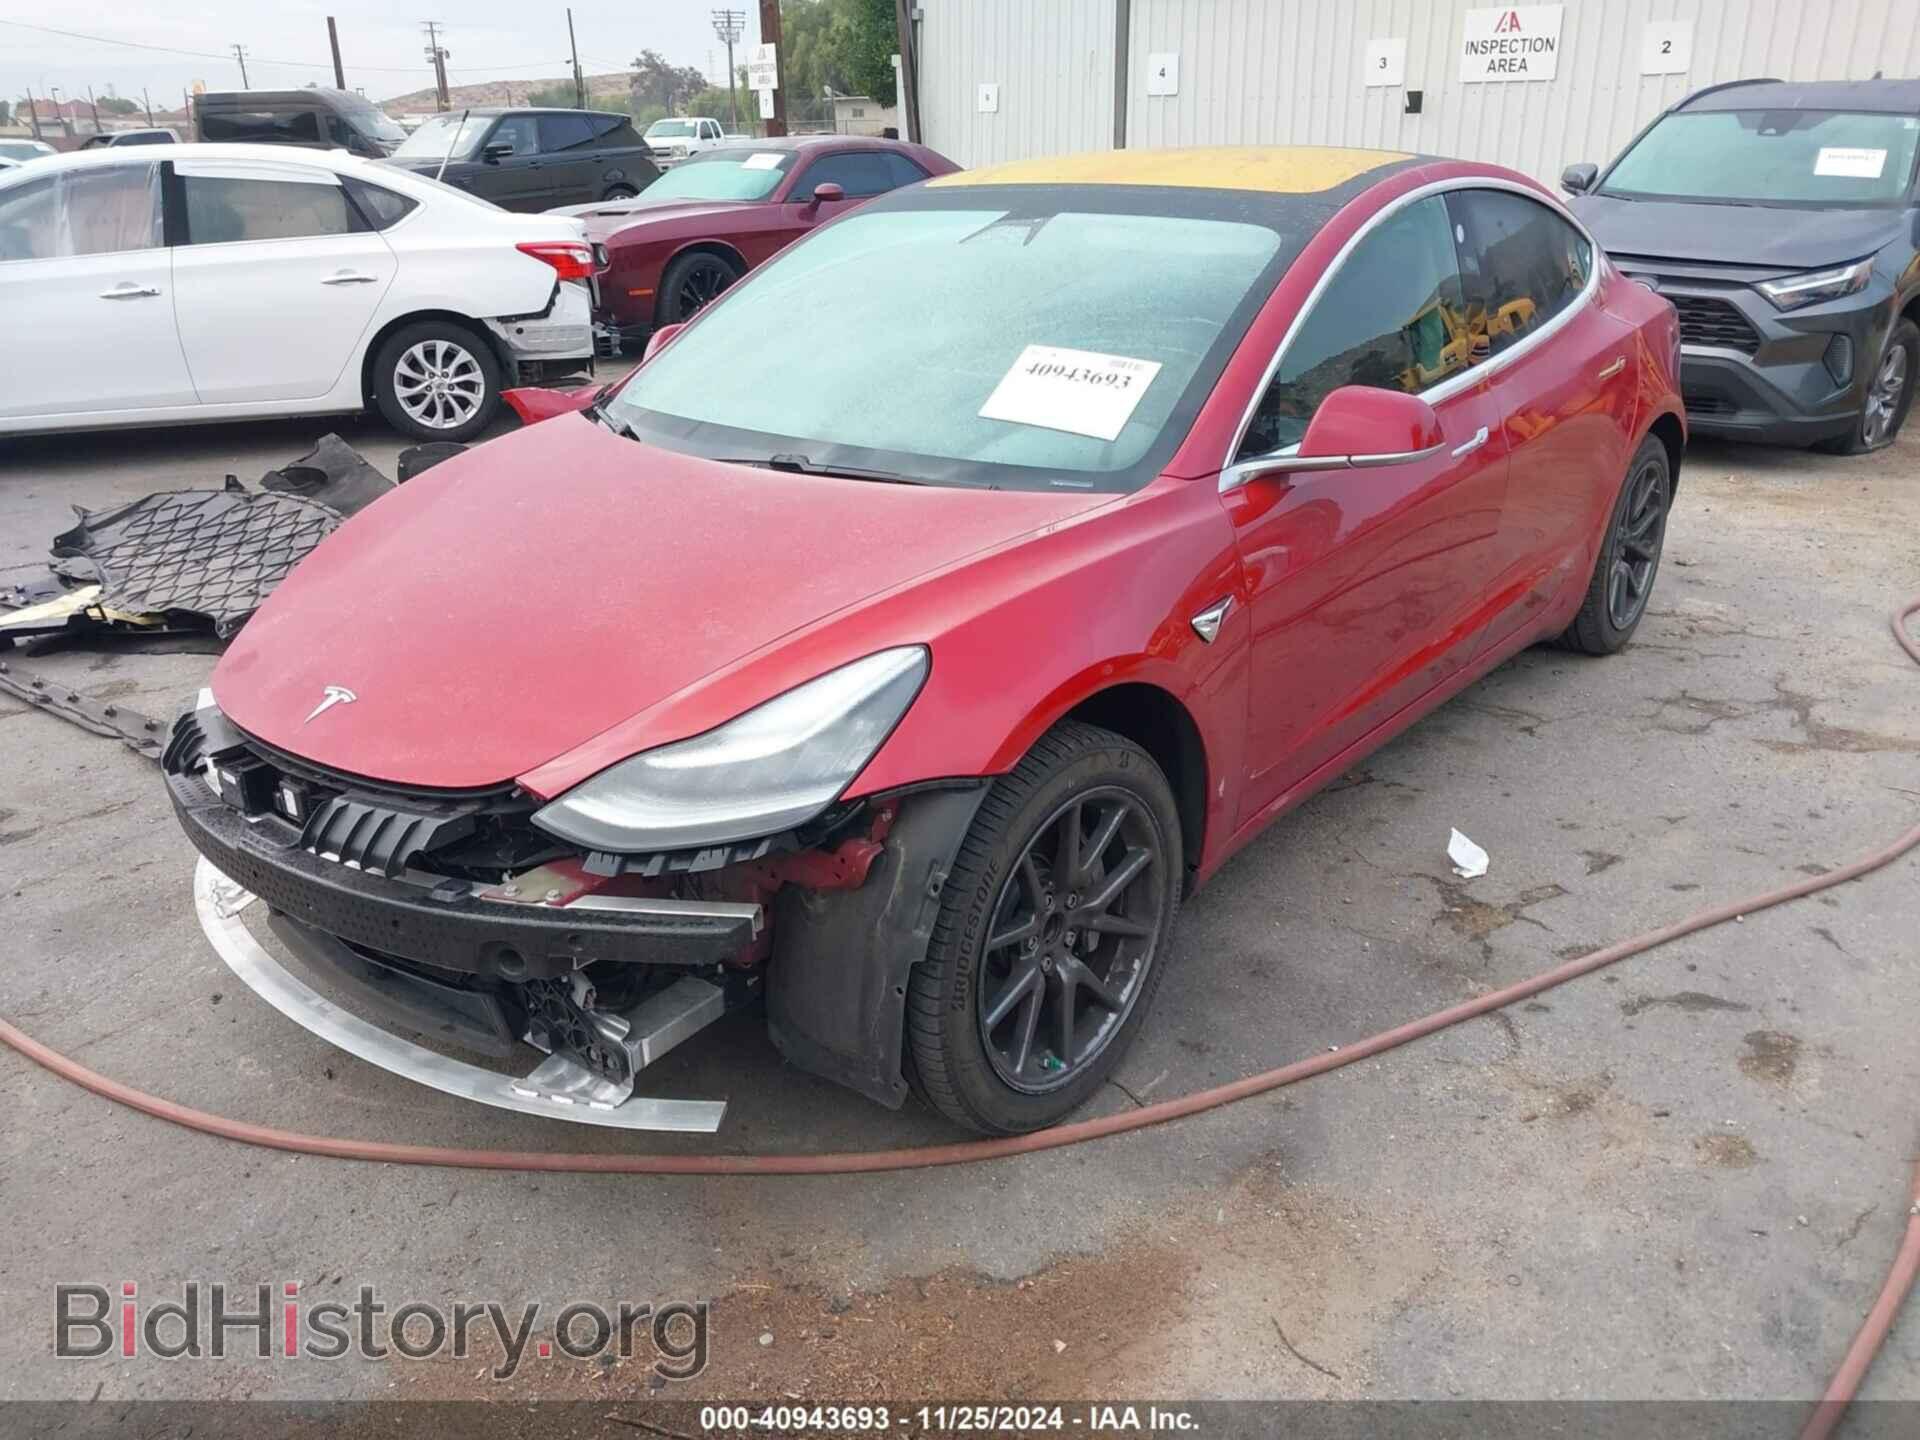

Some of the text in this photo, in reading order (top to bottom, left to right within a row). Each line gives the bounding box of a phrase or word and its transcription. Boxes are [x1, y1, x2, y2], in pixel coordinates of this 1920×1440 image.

[1464, 36, 1556, 56] INSPECTION
[1660, 39, 1672, 54] 2
[1378, 56, 1388, 69] 3
[1486, 57, 1528, 73] AREA
[1158, 66, 1166, 79] 4
[1025, 361, 1133, 390] 40943693
